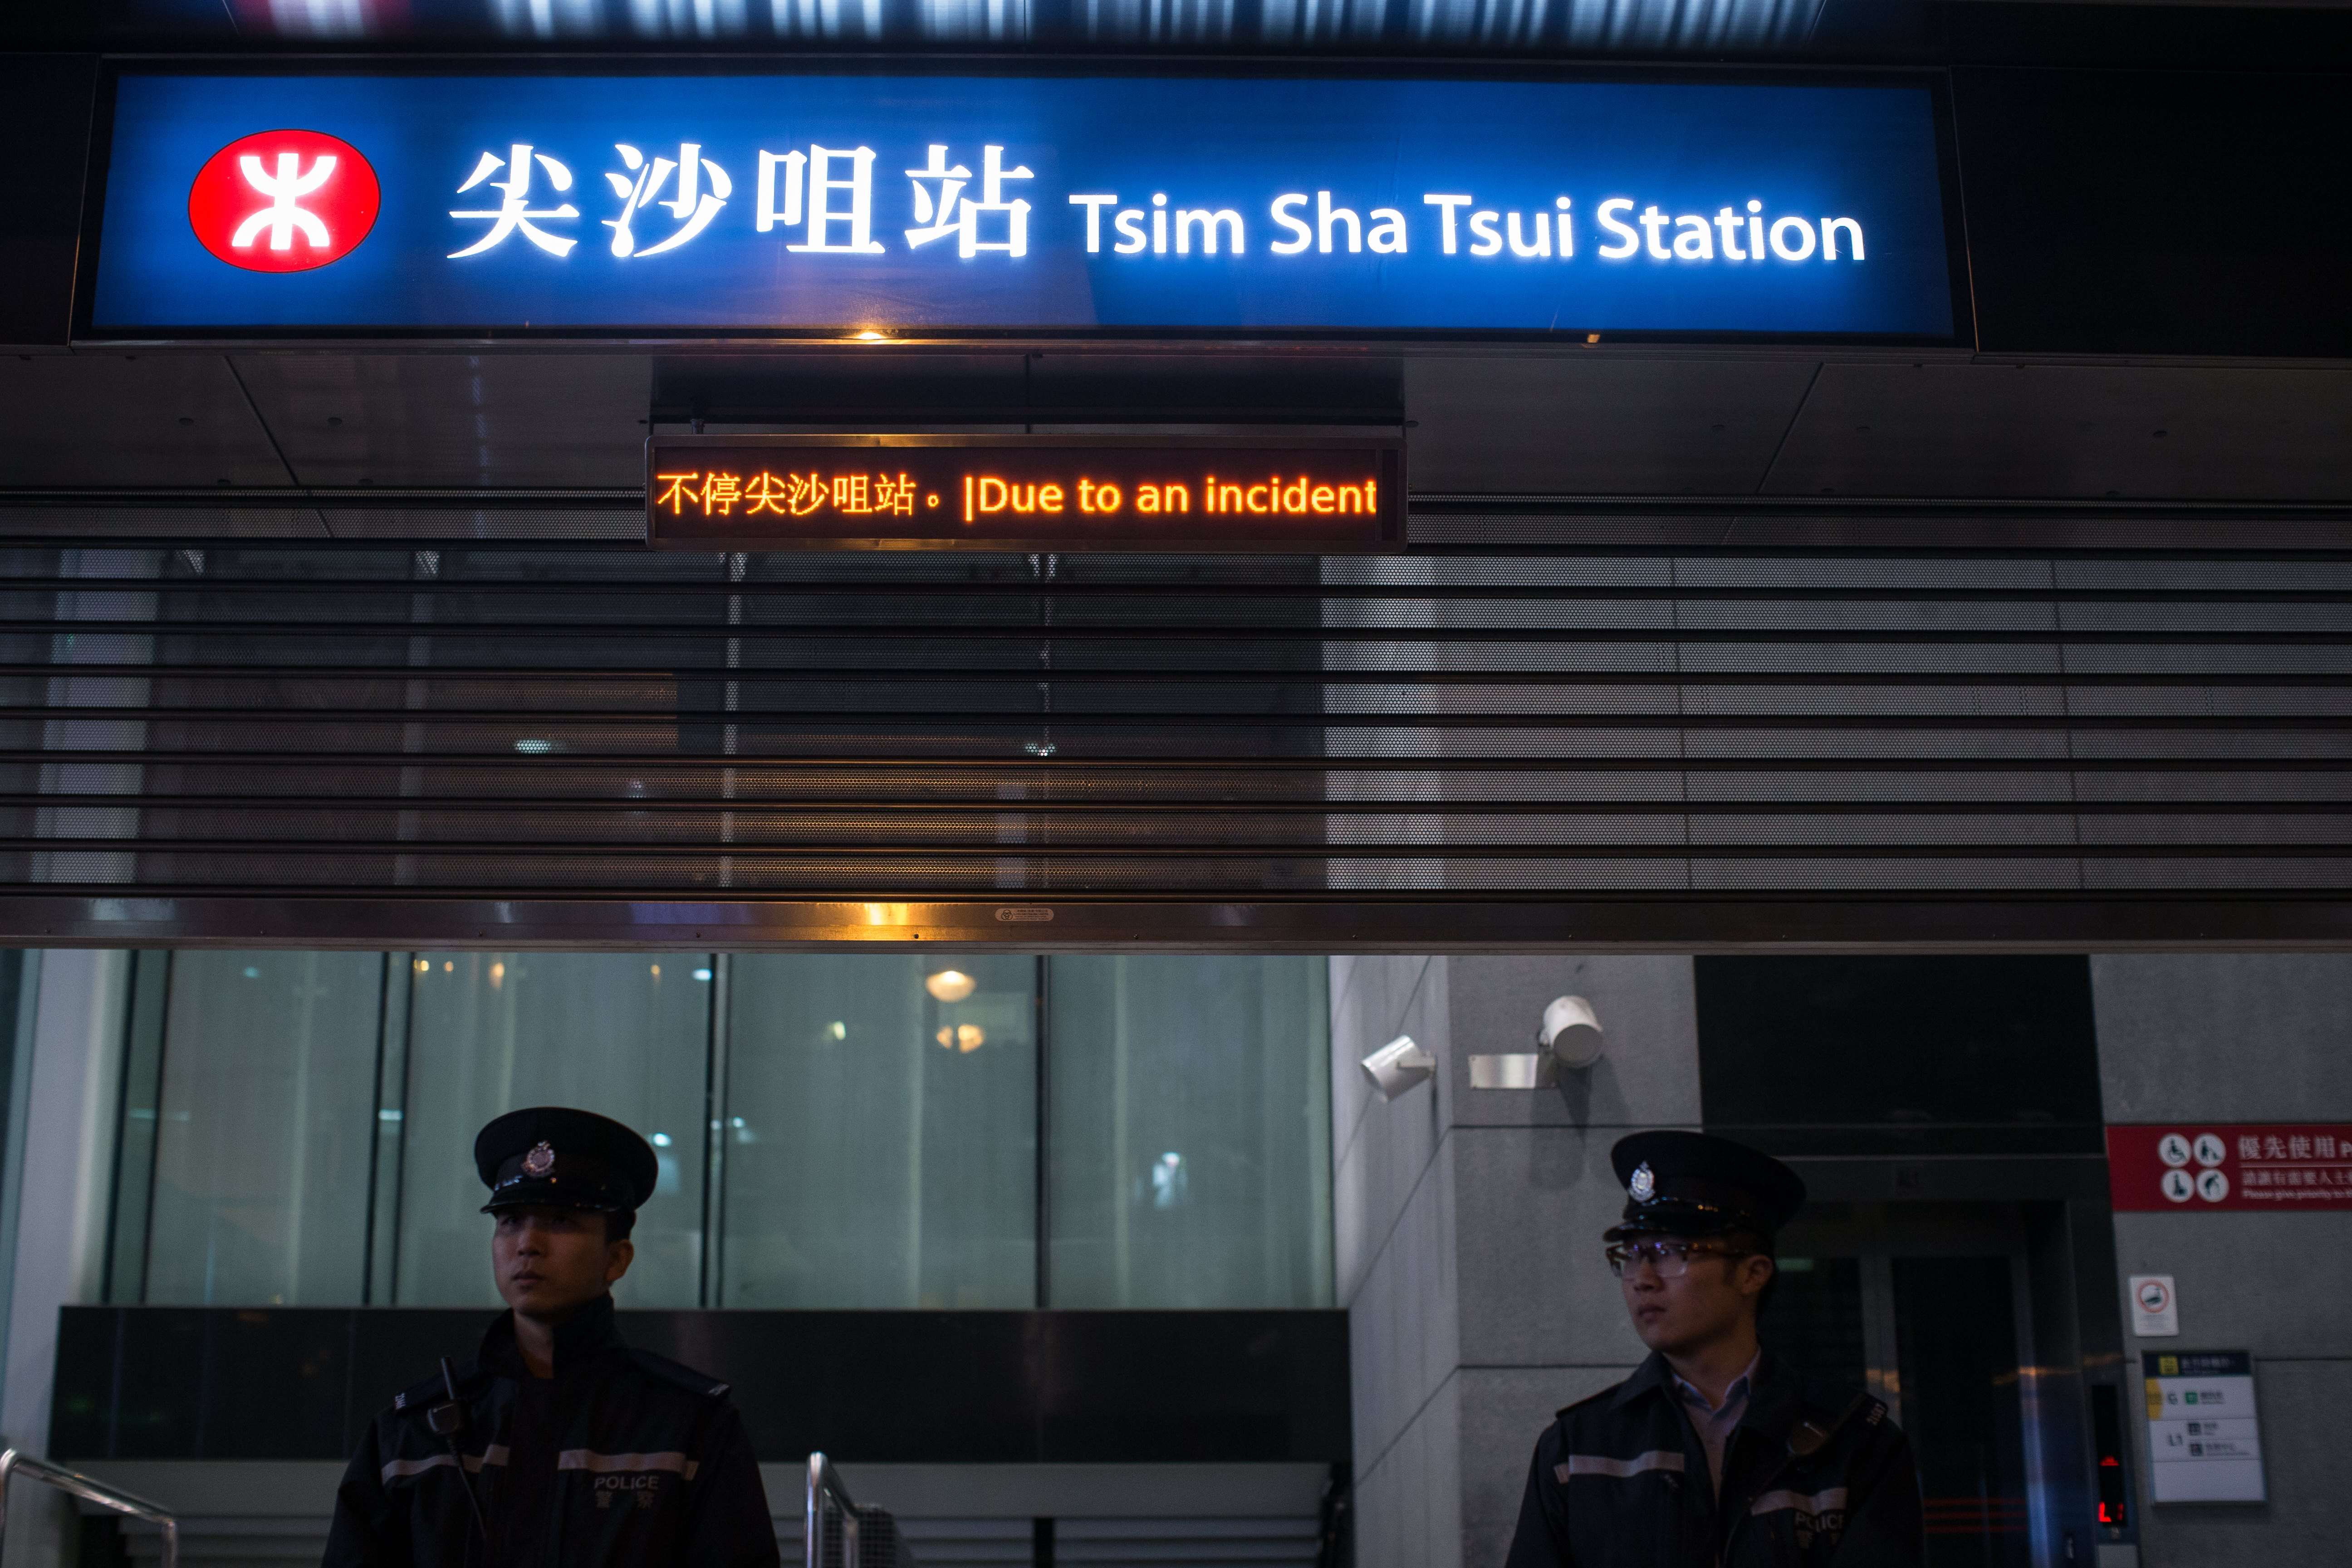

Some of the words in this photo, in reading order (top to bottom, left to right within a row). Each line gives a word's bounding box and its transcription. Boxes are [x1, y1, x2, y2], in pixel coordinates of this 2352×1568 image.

[447, 143, 1034, 258] 尖沙咀站
[1069, 193, 1244, 254] Tsim
[1271, 191, 1407, 255] Sha
[1424, 194, 1573, 258] Tsui
[1597, 198, 1864, 260] Station
[1076, 477, 1123, 514] to
[1134, 482, 1191, 514] an
[1204, 475, 1377, 515] incident
[594, 1475, 659, 1489] POLICE
